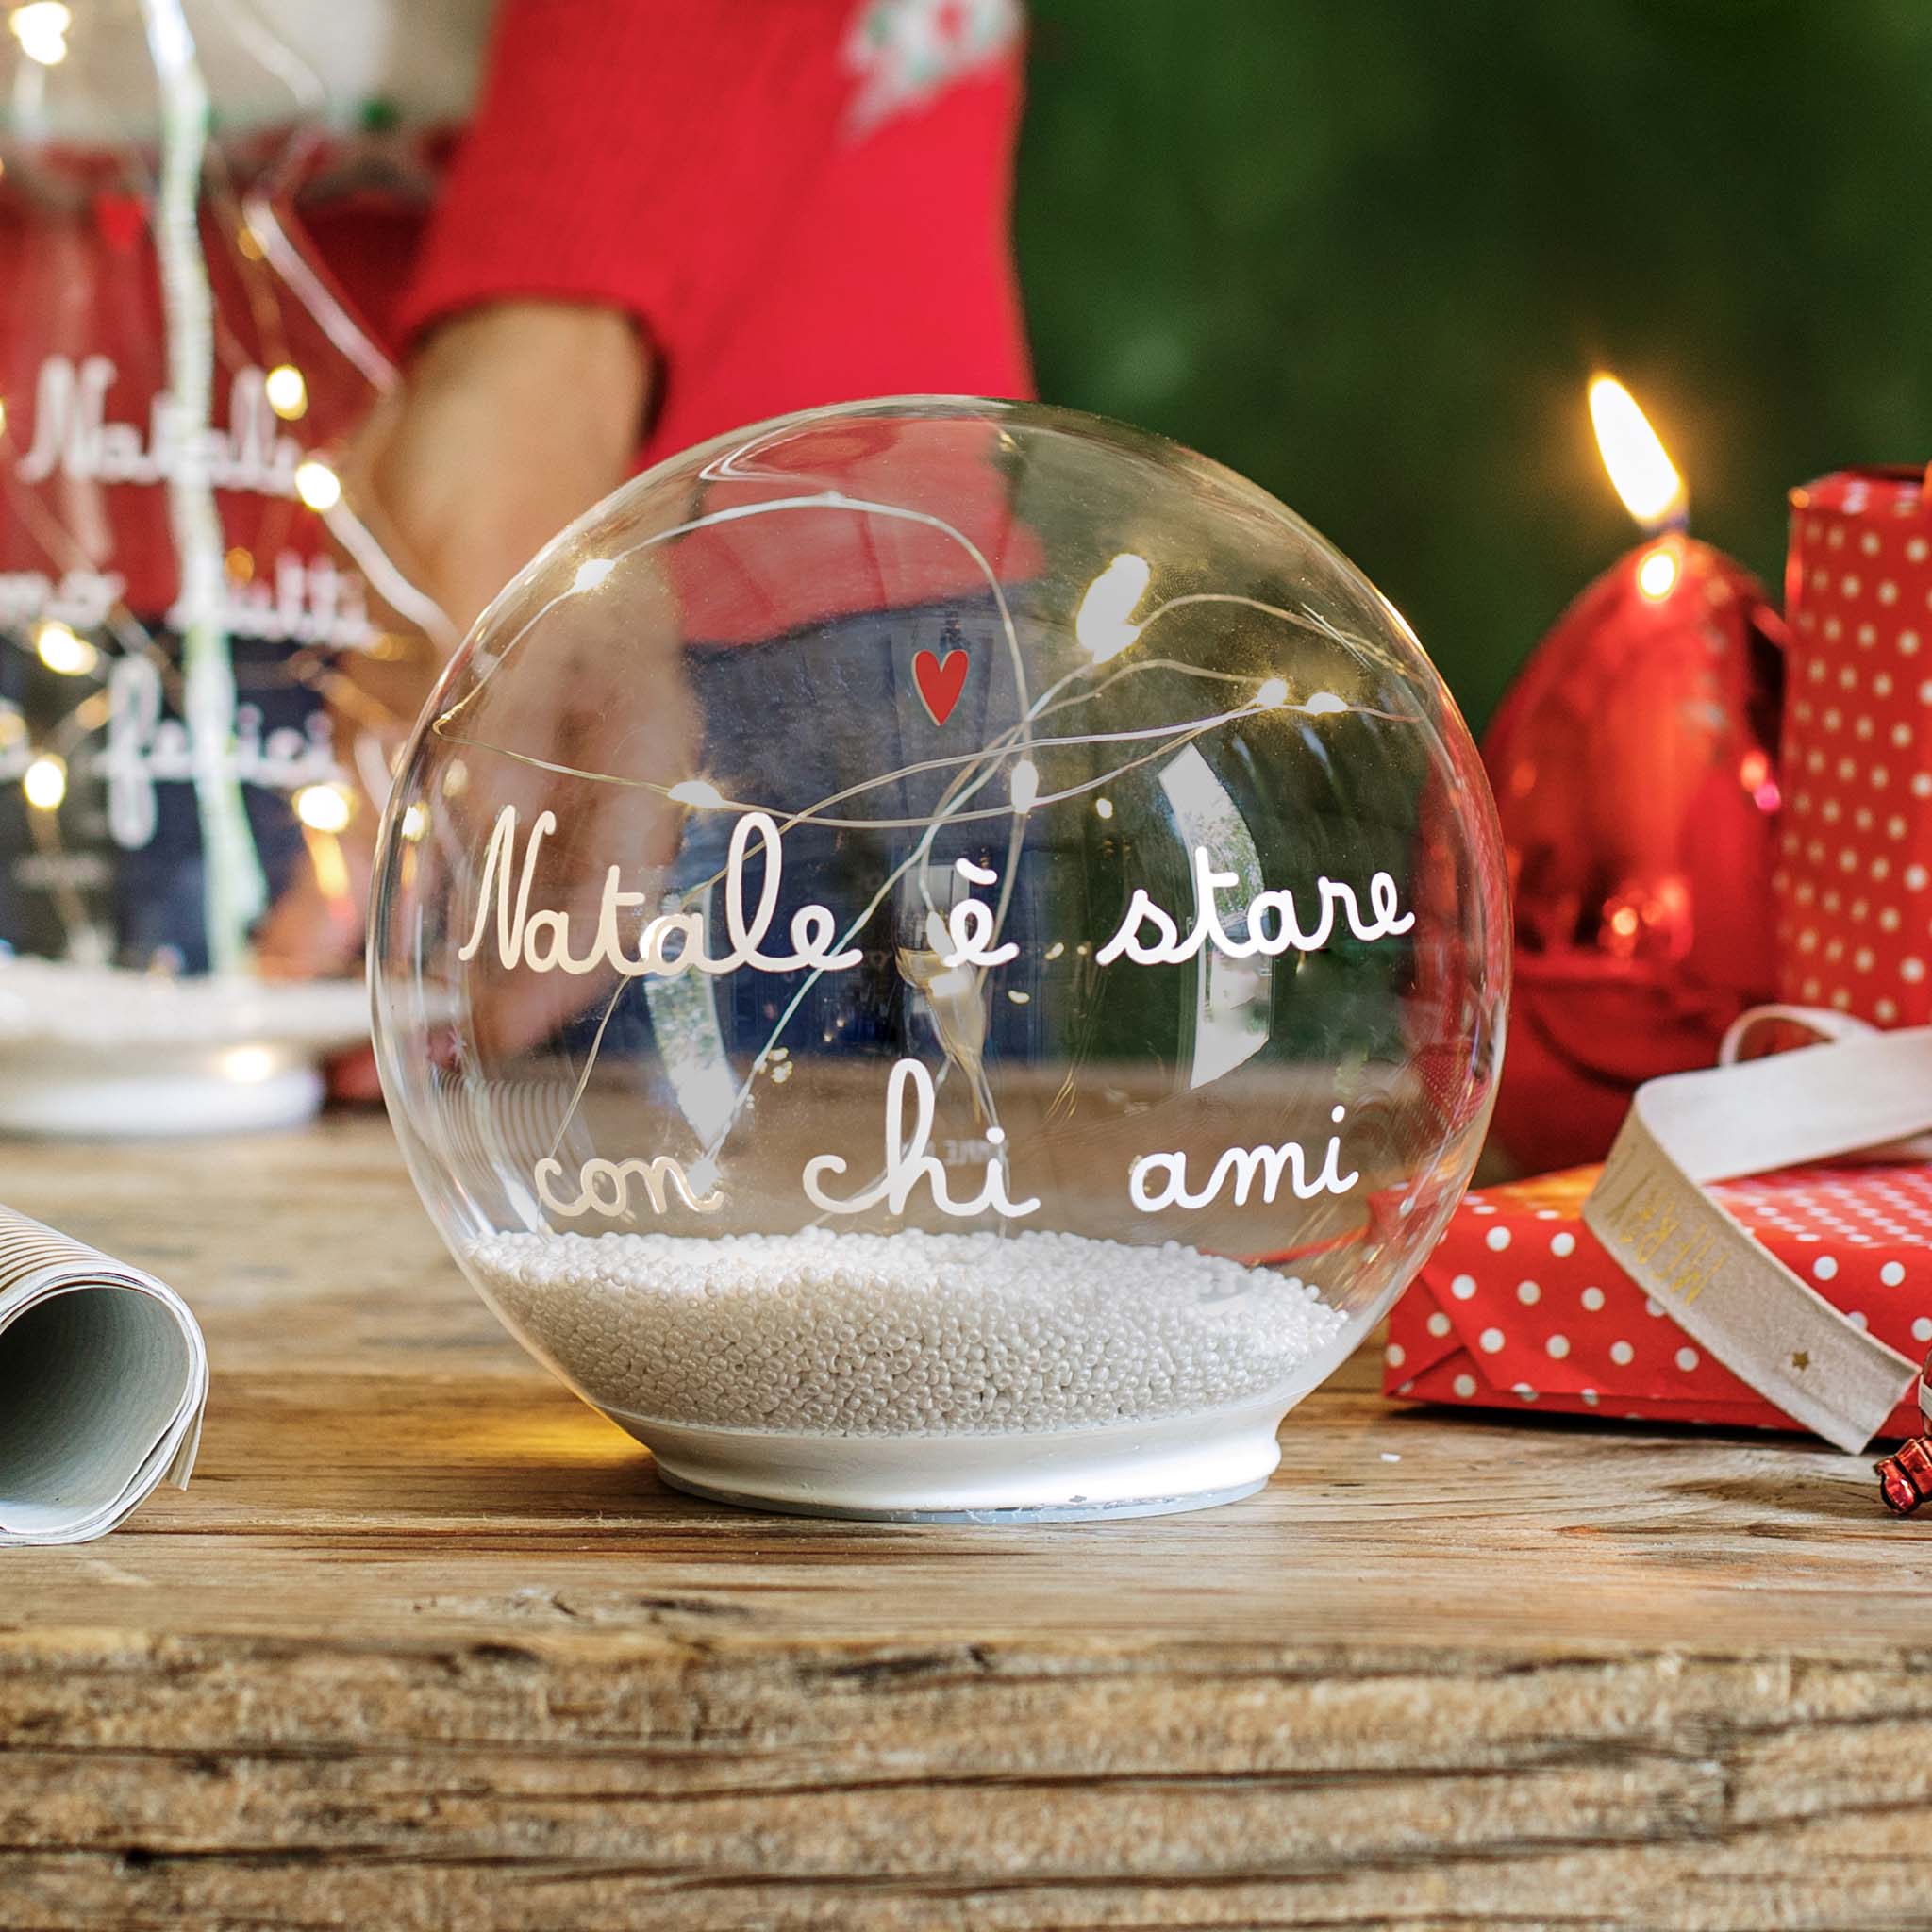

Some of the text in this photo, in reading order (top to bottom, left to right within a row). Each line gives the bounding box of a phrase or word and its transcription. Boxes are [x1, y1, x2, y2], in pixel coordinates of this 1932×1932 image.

[458, 804, 1416, 976] Natale è stare
[534, 1058, 1360, 1218] con chi ami
